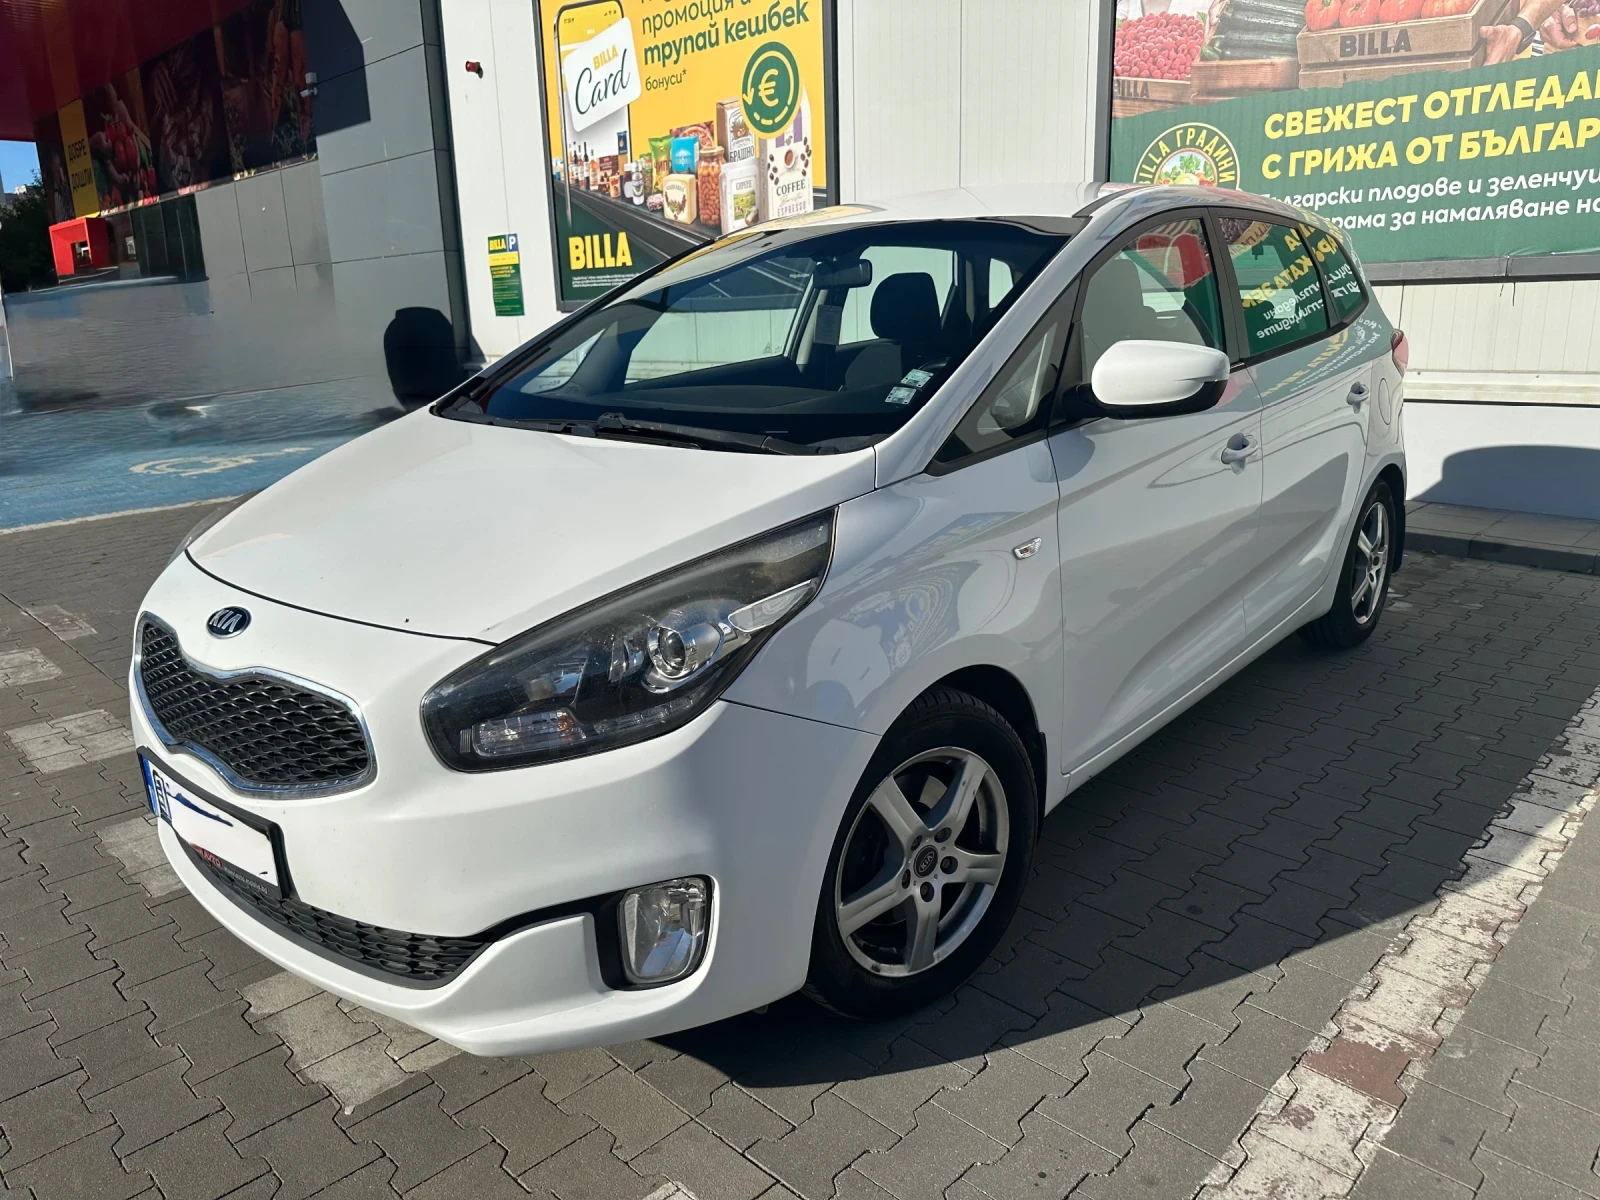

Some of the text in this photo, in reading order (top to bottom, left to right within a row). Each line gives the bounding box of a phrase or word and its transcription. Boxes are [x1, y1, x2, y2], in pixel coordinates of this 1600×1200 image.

[642, 0, 734, 38] промоция
[644, 1, 810, 68] трупай кешбек
[1340, 28, 1411, 57] BILLA
[593, 44, 619, 70] BILLA
[575, 48, 630, 114] Card
[1264, 69, 1600, 139] СВЕЖЕСТ ОТГЛЕДА
[68, 138, 87, 164] ДОБРЕ
[729, 145, 754, 163] БРАШНО
[1138, 140, 1170, 184] ILLA
[1176, 127, 1236, 183] ГРАДИНИ
[1262, 117, 1600, 179] С ГРИЖА ОТ БЪЛГАР
[776, 179, 806, 196] COFFEE
[1368, 177, 1462, 204] плодове
[1468, 178, 1482, 194] и
[777, 200, 806, 218] ESPRESSO
[1389, 211, 1415, 232] за
[1421, 198, 1569, 224] намаляване
[489, 236, 516, 251] BILLA P
[568, 231, 633, 270] BILLA
[209, 609, 243, 633] KIA
[920, 854, 934, 870] KIA
